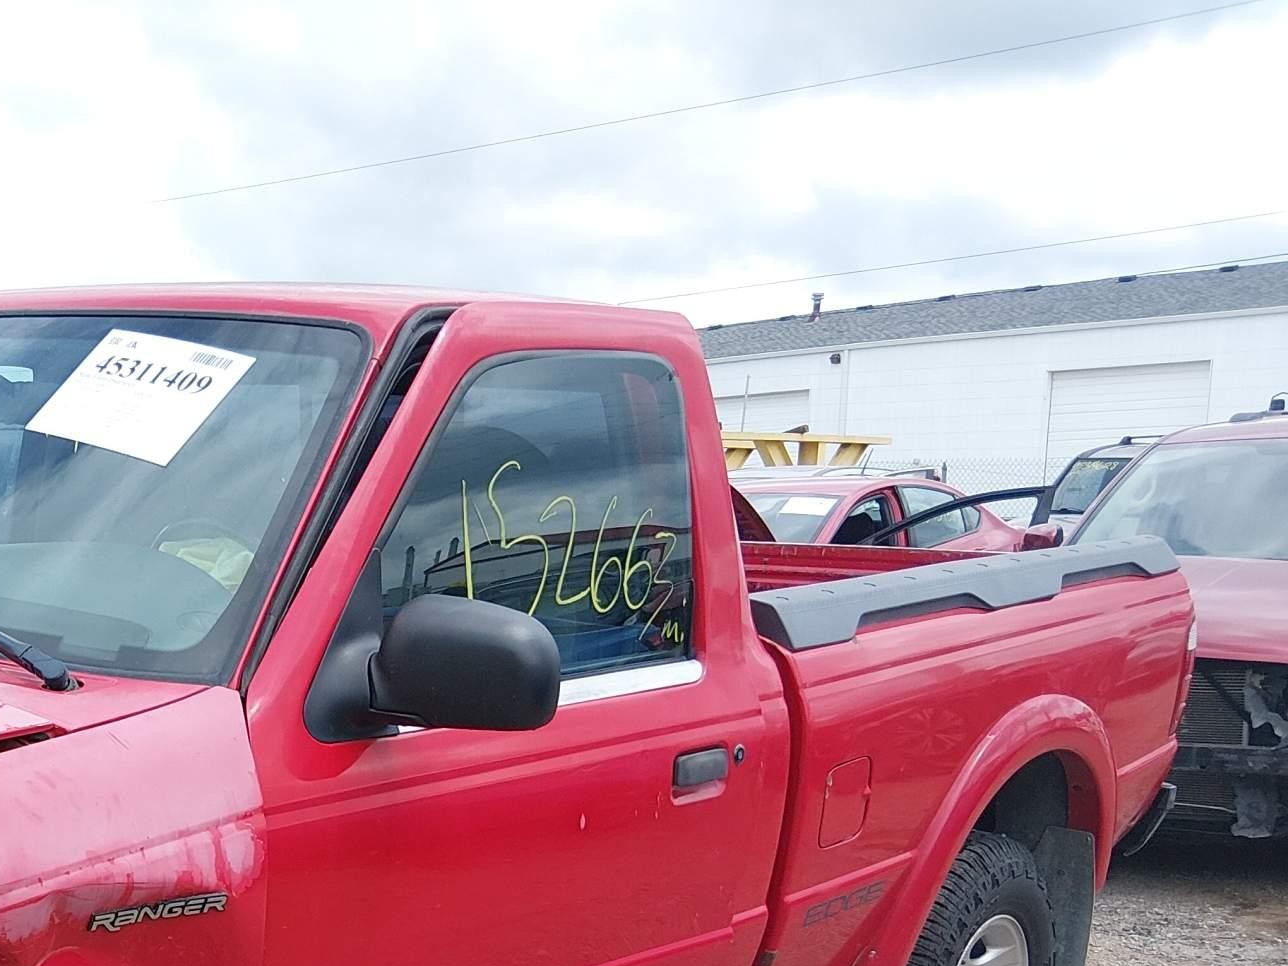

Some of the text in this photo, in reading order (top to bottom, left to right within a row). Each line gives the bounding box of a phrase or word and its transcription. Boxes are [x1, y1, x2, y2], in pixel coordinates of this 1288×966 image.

[96, 355, 213, 394] 45311409
[461, 460, 677, 641] 152663
[88, 892, 228, 932] RANGER
[803, 880, 888, 928] EDGE
